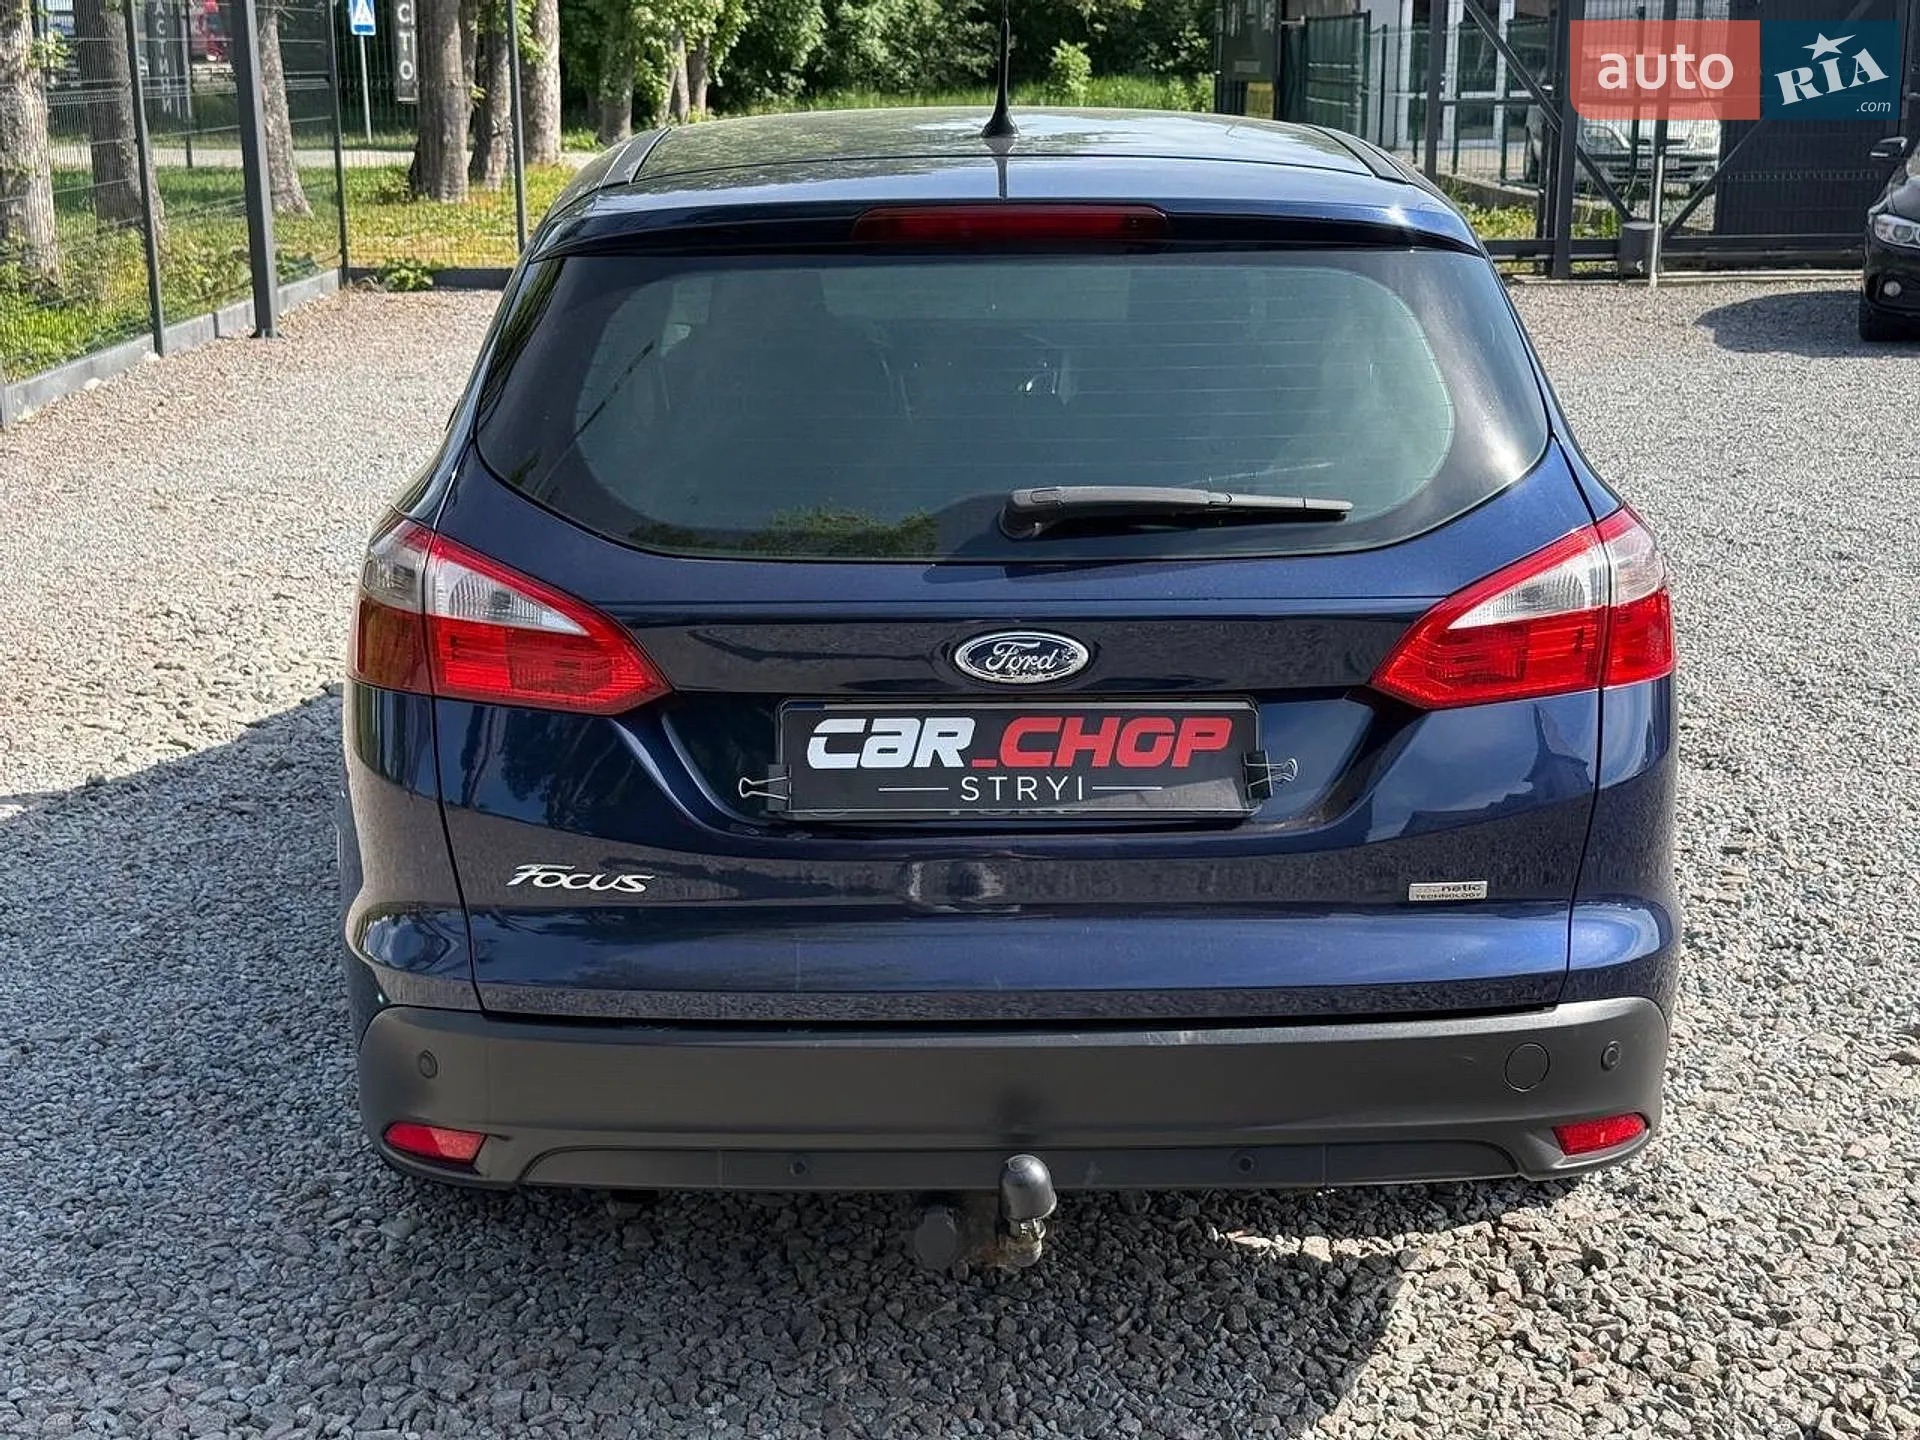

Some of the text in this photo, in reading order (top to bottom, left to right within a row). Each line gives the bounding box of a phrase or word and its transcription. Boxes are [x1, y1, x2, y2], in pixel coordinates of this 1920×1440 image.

[397, 4, 414, 80] СТО
[985, 640, 1059, 672] Ford
[960, 775, 1083, 801] STRYI
